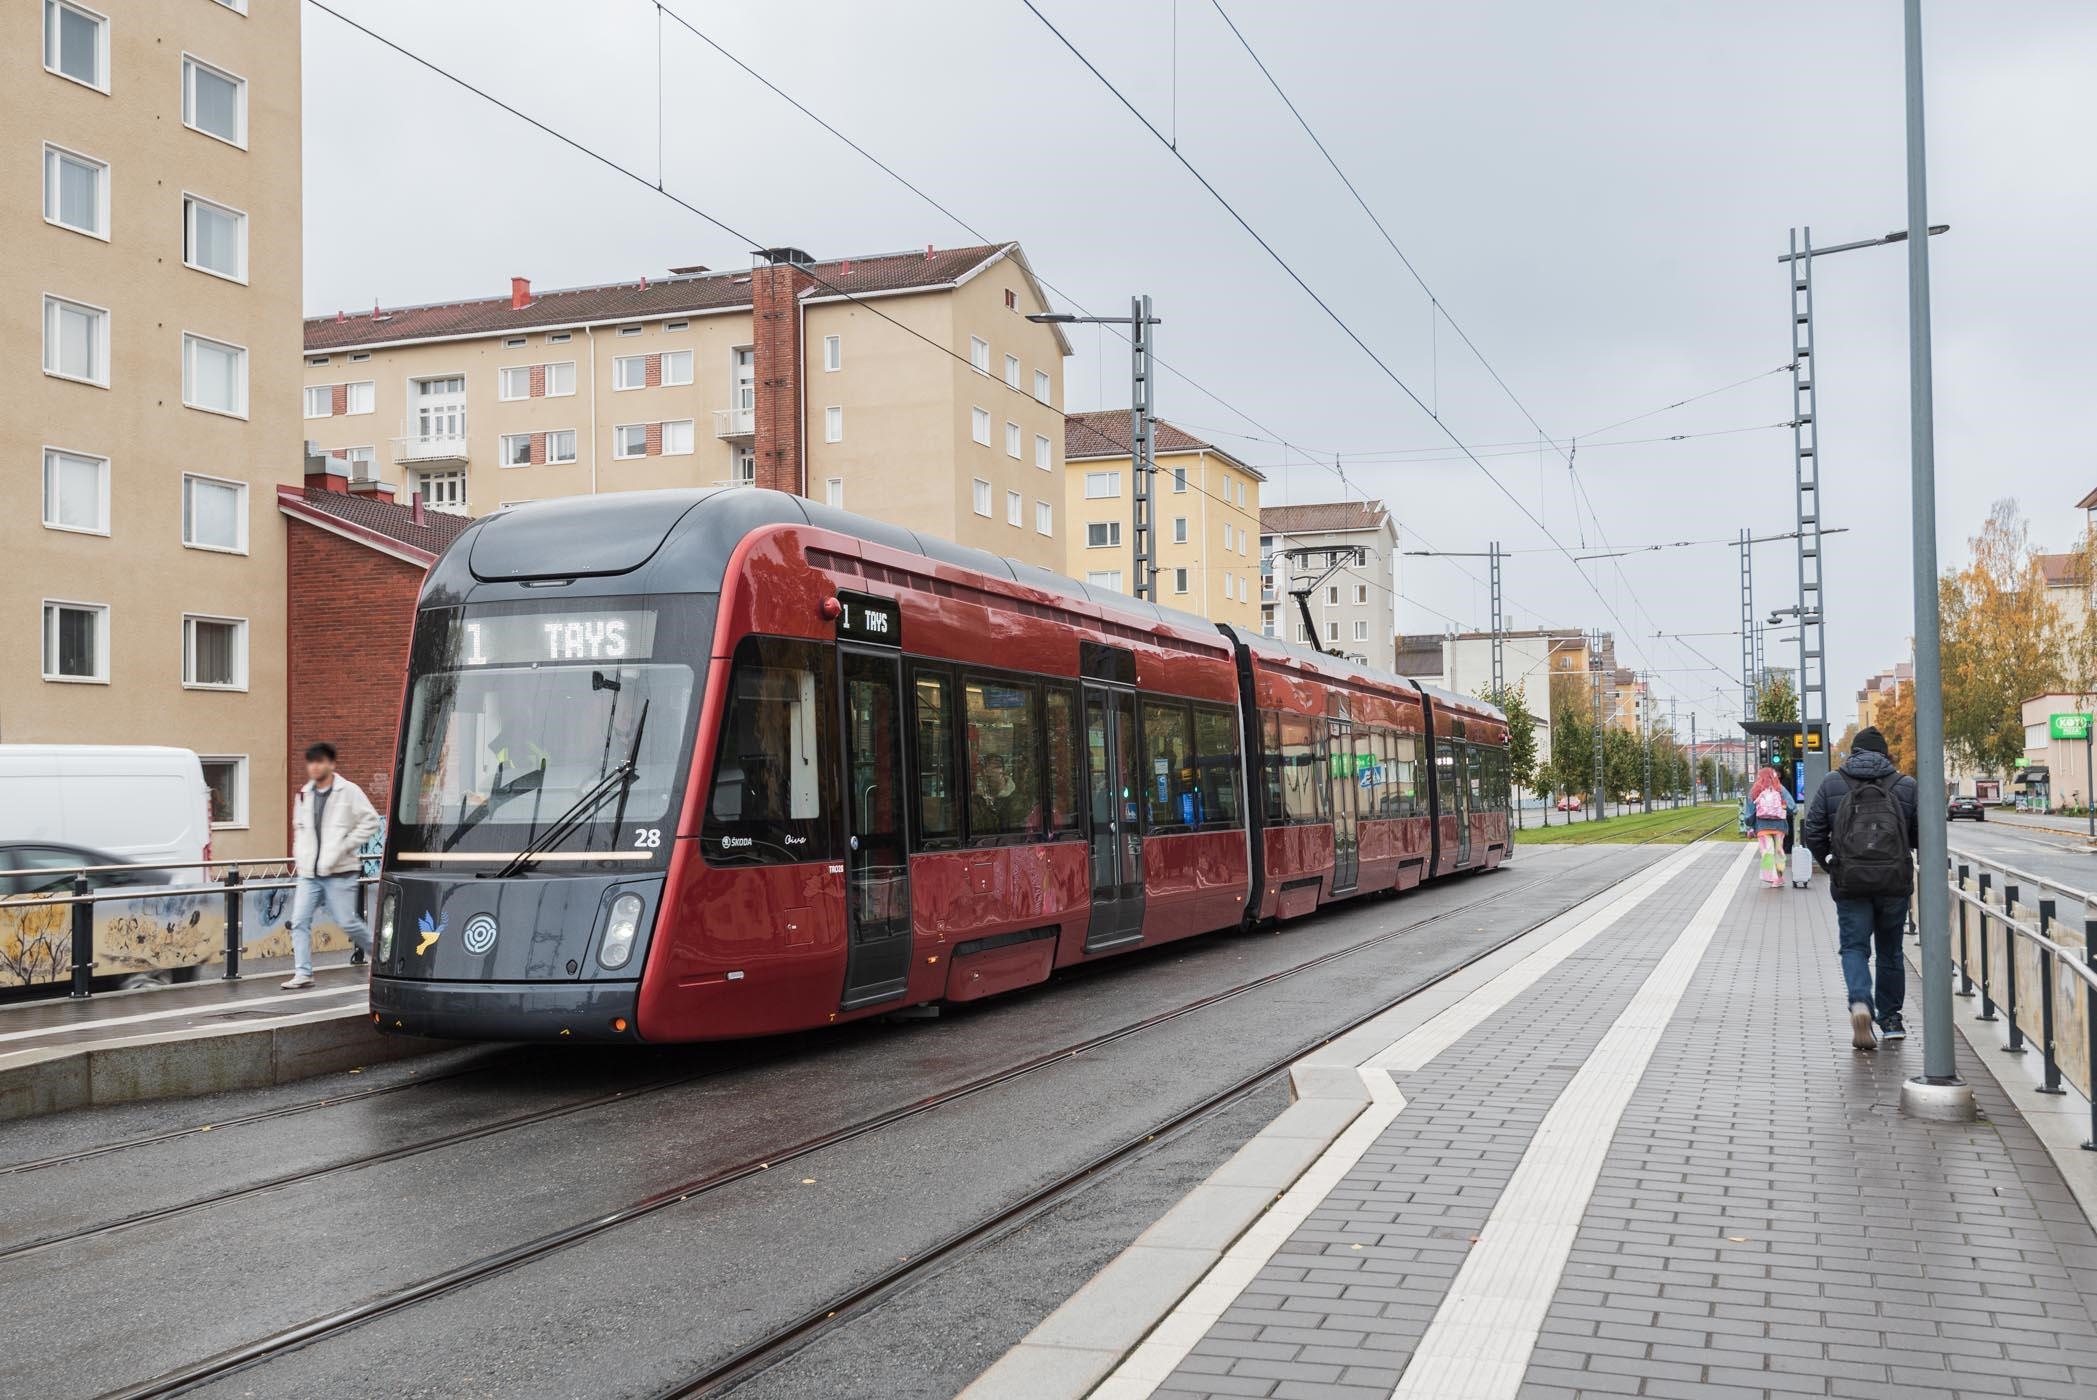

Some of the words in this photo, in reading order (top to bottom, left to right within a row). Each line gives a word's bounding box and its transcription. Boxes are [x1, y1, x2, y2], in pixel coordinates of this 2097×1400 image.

[843, 604, 850, 629] 1
[864, 609, 888, 633] TAYS
[467, 623, 487, 665] 1
[544, 618, 626, 659] TAYS
[634, 828, 661, 848] 28
[731, 836, 752, 847] ŠKODA
